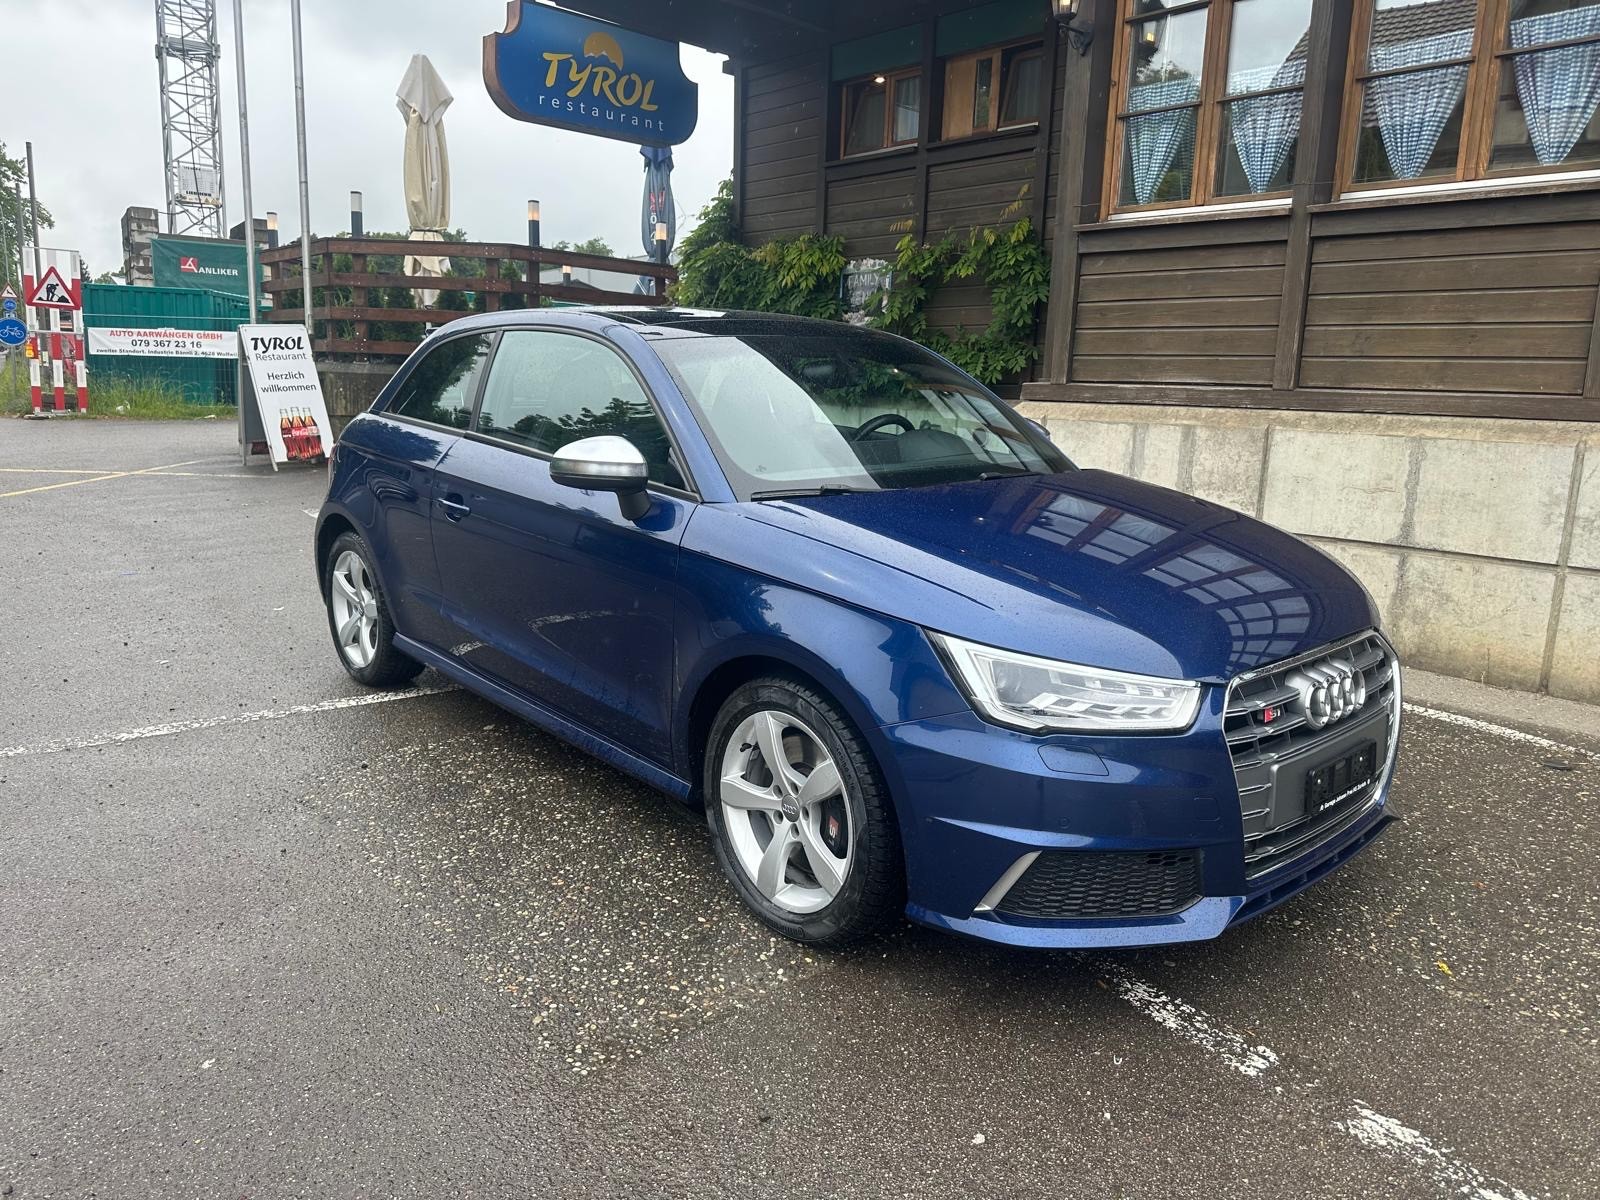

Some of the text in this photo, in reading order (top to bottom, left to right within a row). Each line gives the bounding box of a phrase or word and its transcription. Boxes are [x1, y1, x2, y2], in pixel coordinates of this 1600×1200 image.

[542, 52, 658, 111] TYROL
[539, 95, 664, 131] restaurant
[198, 266, 239, 276] ANLIKER
[109, 330, 134, 338] AUTO
[196, 332, 223, 340] GMBH
[131, 339, 202, 349] 079 367 23 16
[250, 336, 304, 354] TYROL
[255, 352, 307, 361] Restaurant
[266, 371, 305, 380] Herzlich
[261, 384, 317, 393] willkommen
